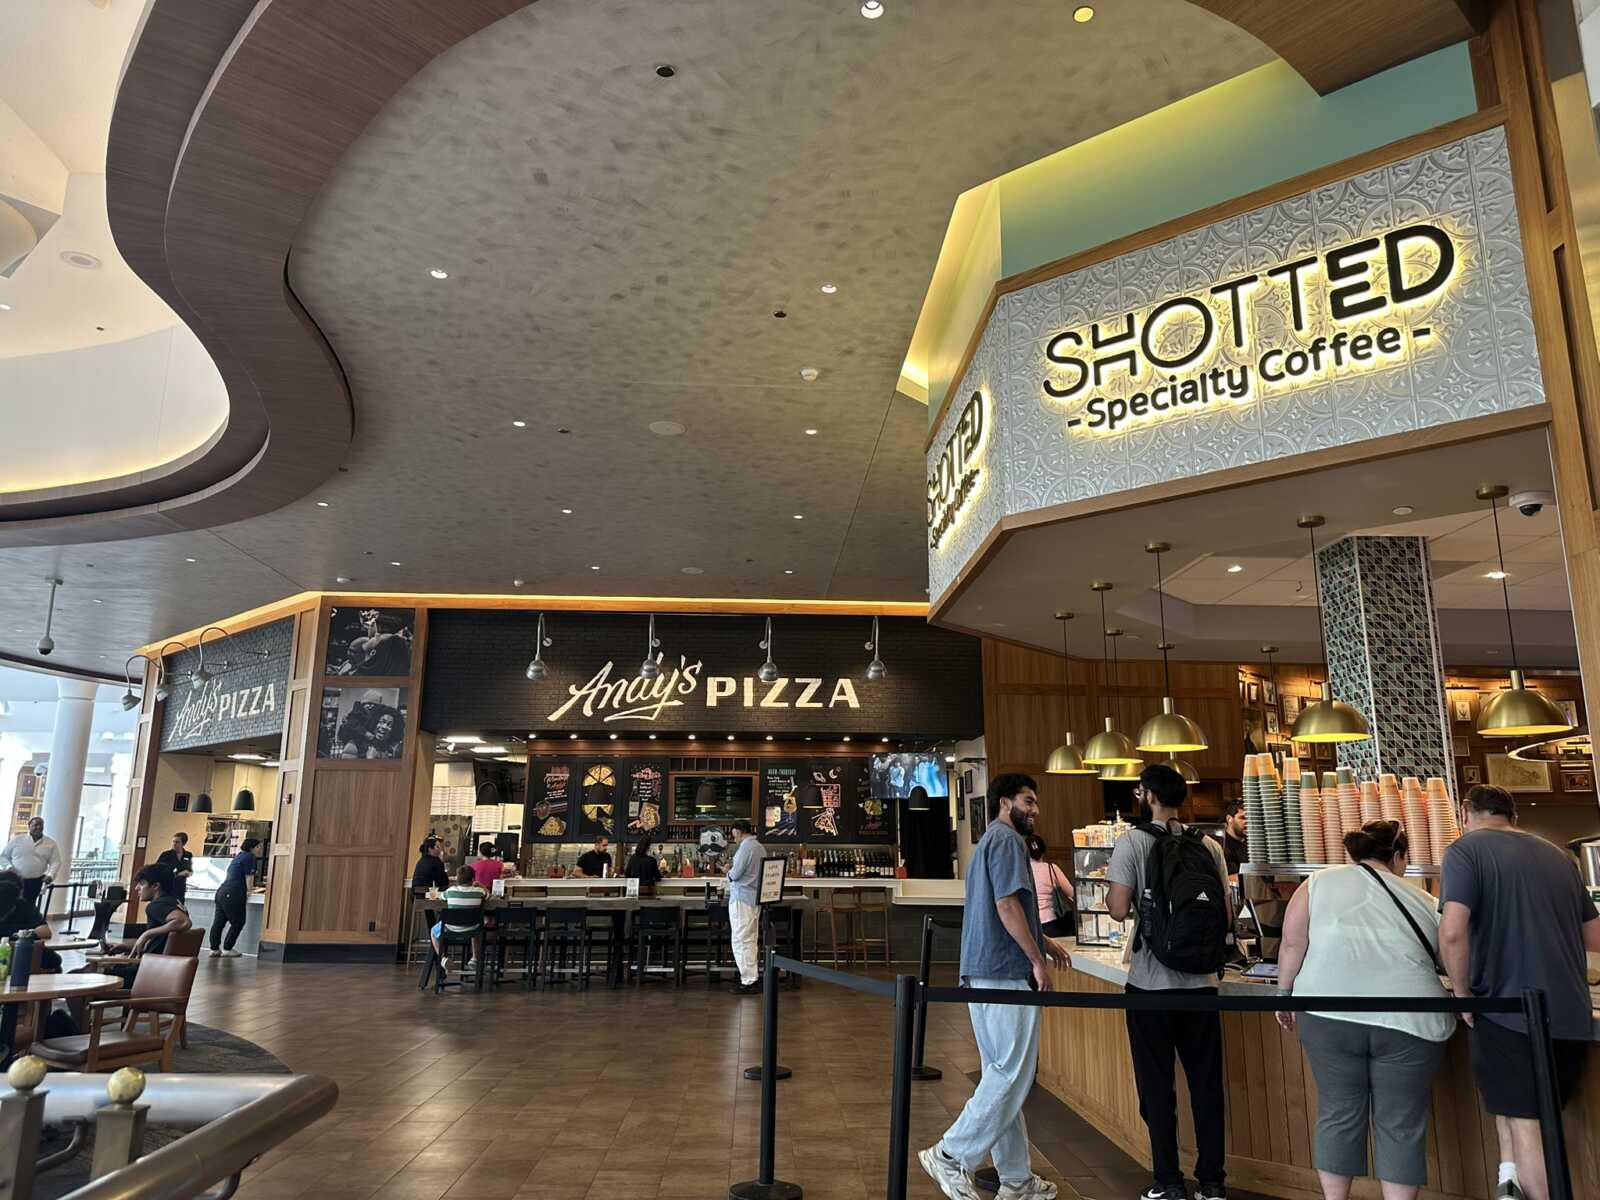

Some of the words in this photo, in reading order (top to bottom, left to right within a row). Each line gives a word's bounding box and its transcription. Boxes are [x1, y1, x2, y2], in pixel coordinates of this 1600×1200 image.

[1043, 224, 1455, 398] SHOTTED
[168, 679, 223, 743] Andy's
[219, 682, 275, 721] PIZZA
[547, 652, 703, 722] Andy's
[706, 676, 861, 708] PIZZA
